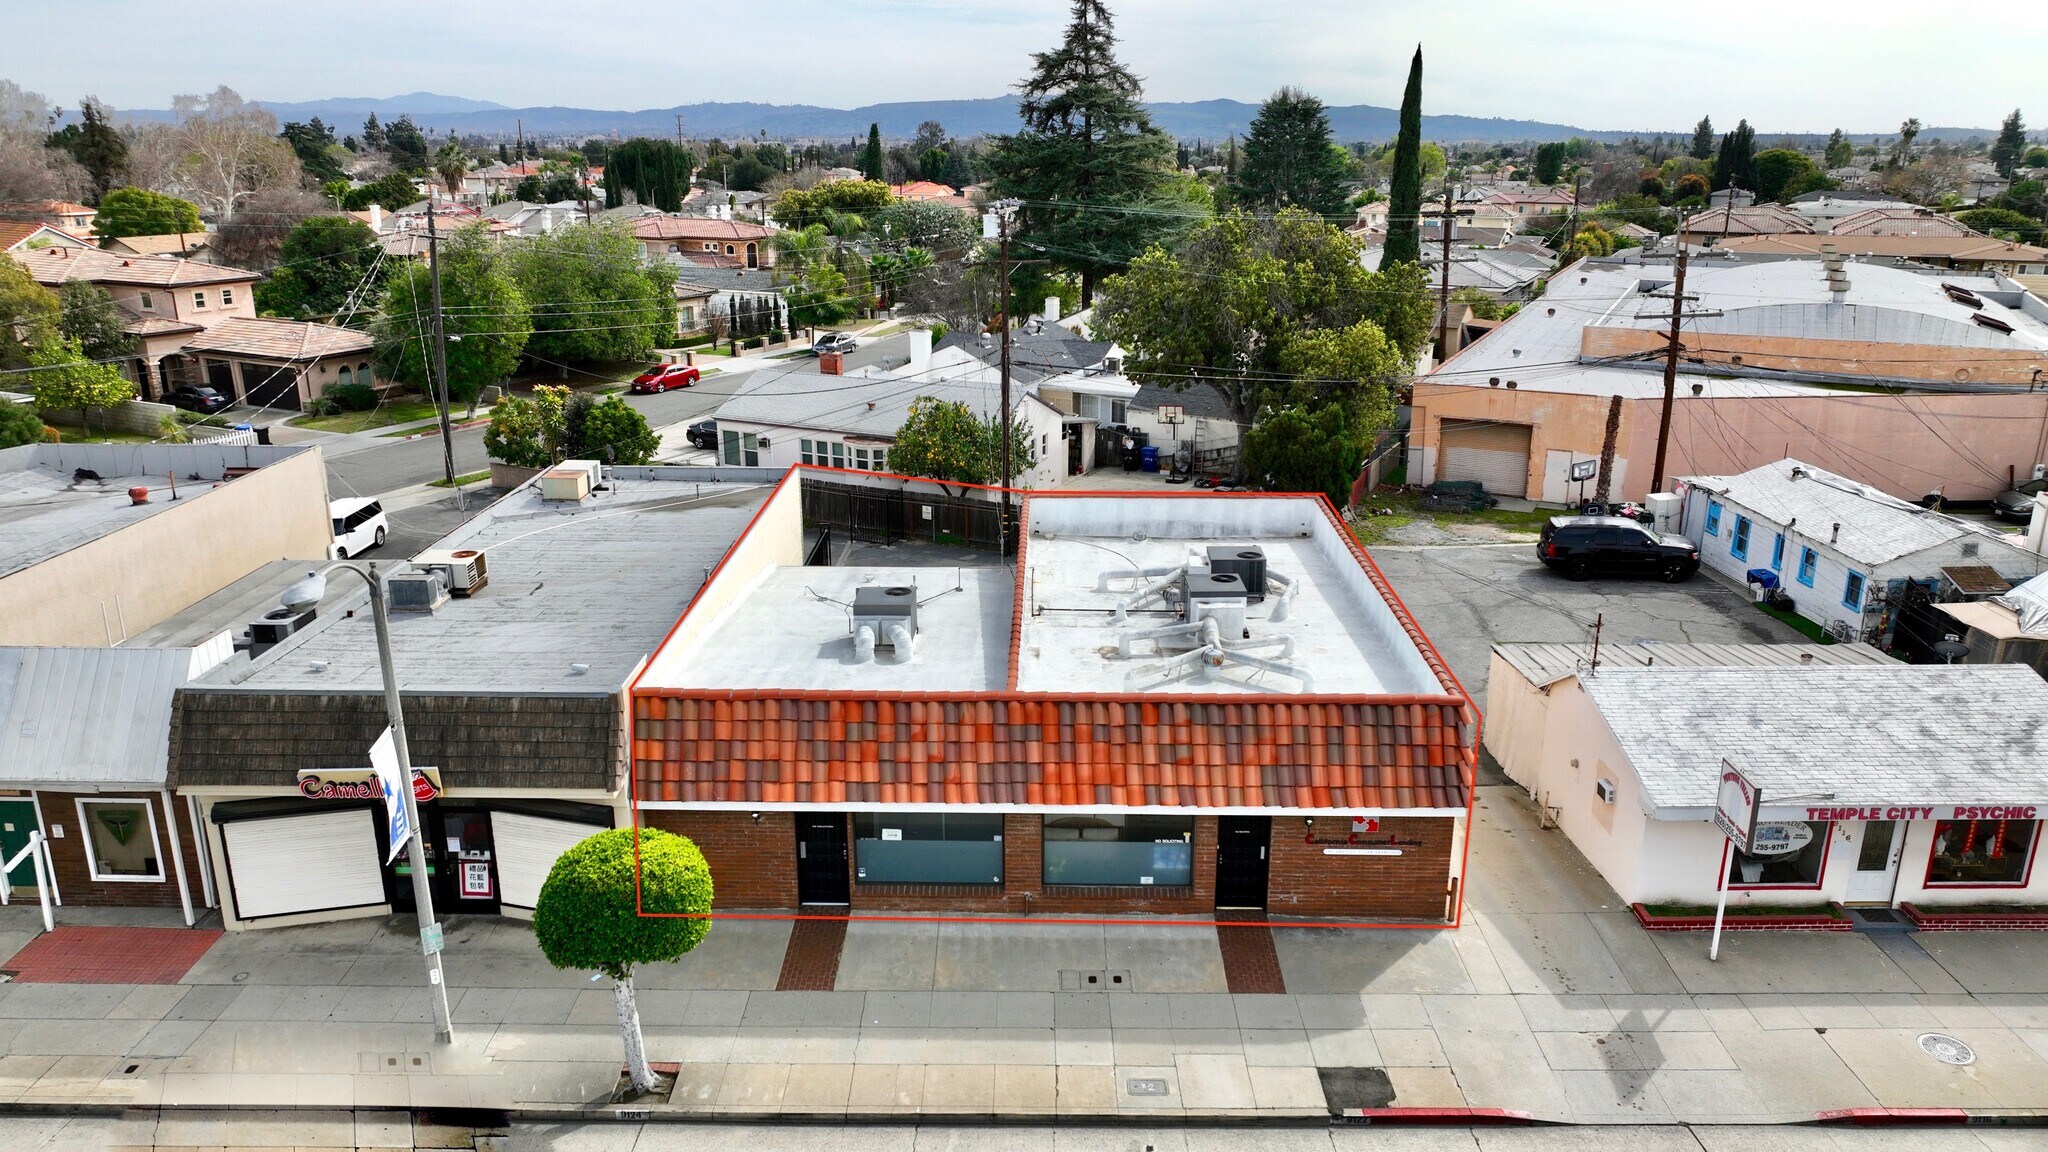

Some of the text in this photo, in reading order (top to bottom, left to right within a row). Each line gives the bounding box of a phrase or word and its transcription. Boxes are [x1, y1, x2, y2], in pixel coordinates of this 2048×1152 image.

[299, 777, 386, 799] Camell
[1807, 806, 2037, 820] TEMPLE CITY PSYCHIC
[1305, 834, 1422, 846] California Consumer Lending
[1755, 843, 1789, 851] 255-9797
[620, 1111, 641, 1119] 9124
